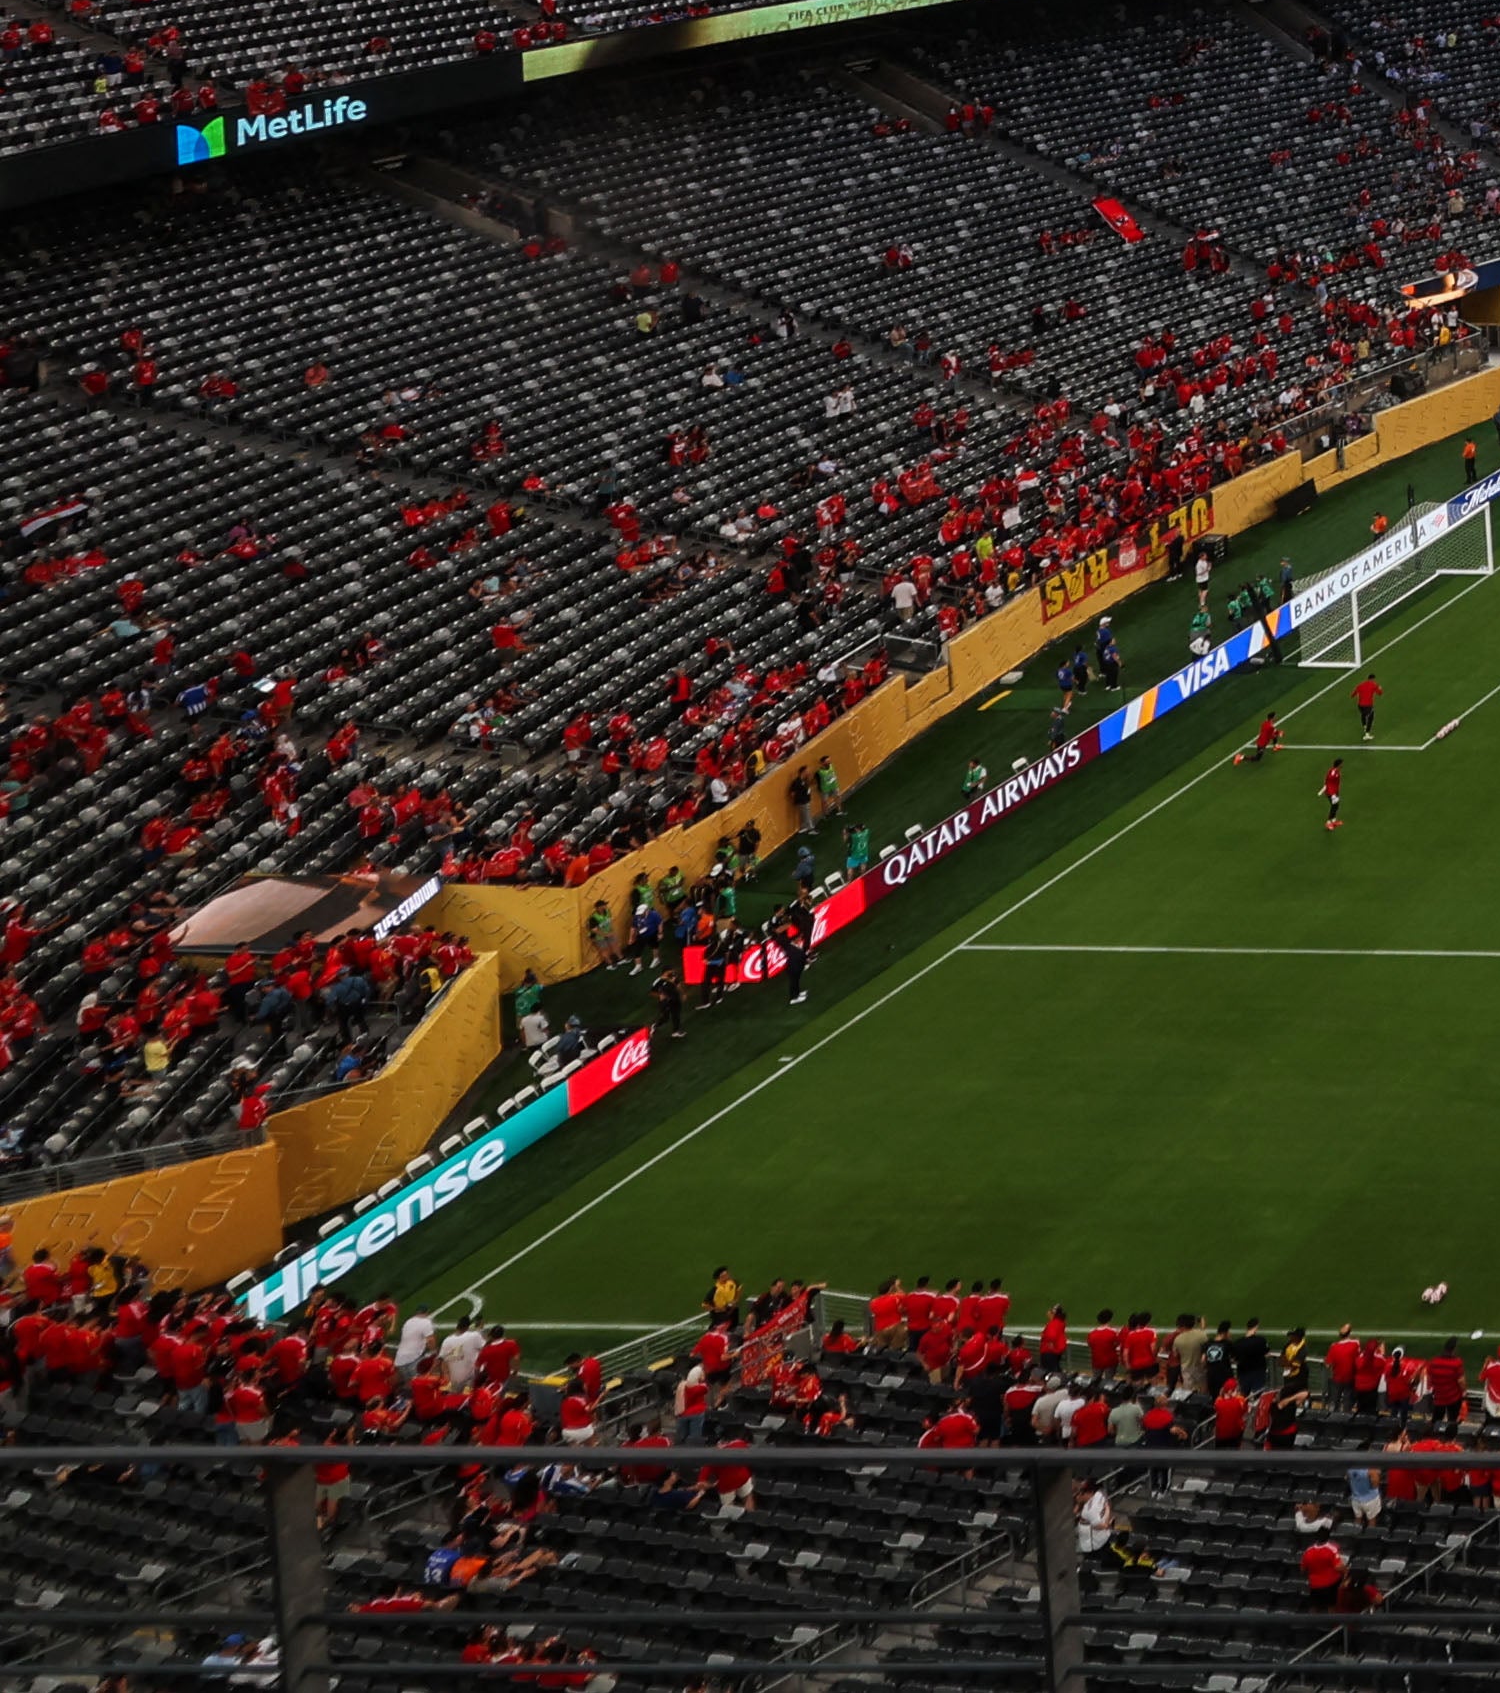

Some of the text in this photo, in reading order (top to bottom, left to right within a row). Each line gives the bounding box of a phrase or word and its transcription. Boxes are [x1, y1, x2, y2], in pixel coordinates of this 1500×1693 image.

[788, 9, 812, 21] FIFA
[816, 4, 845, 17] CLUB
[236, 95, 368, 147] MetLife
[1292, 580, 1336, 620] BANK
[1339, 565, 1358, 590] OF
[1172, 645, 1231, 699] VISA
[881, 739, 1083, 887] QATAR AIRWAYS
[246, 1138, 508, 1321] Hisense
